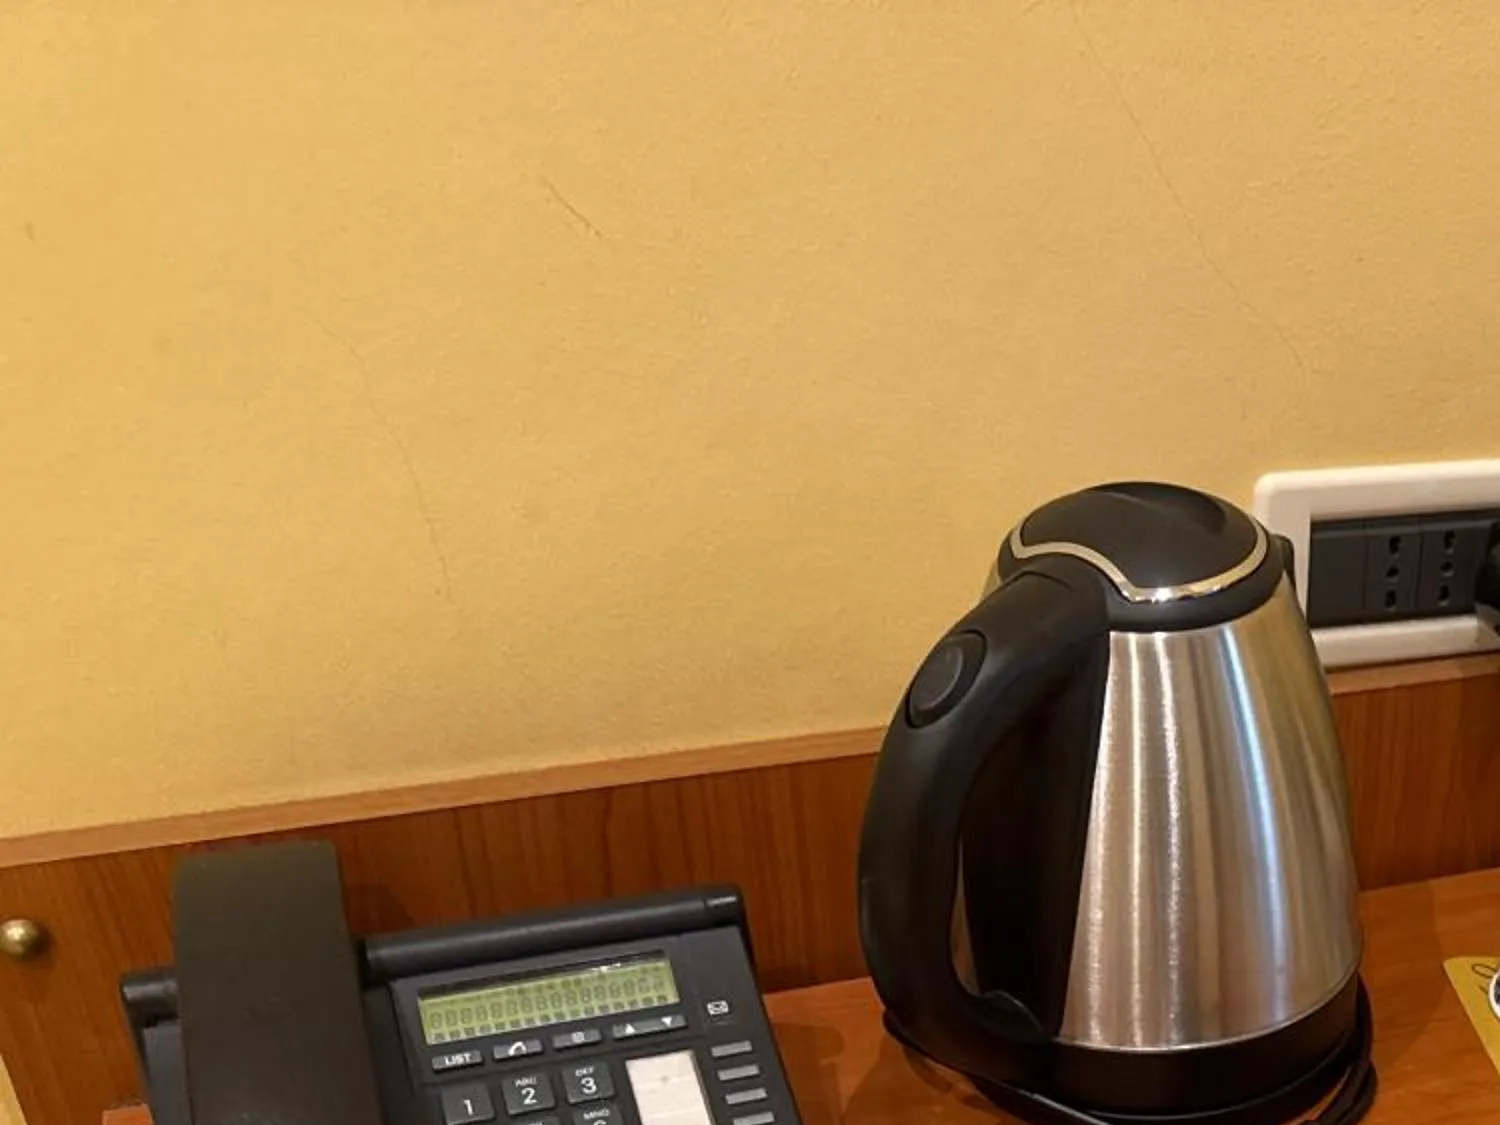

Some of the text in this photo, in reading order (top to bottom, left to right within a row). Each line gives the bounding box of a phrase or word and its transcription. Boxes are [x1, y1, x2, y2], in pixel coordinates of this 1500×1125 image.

[445, 1053, 471, 1065] LIST
[581, 1077, 597, 1094] 3
[521, 1087, 537, 1104] 2
[464, 1099, 473, 1115] 1
